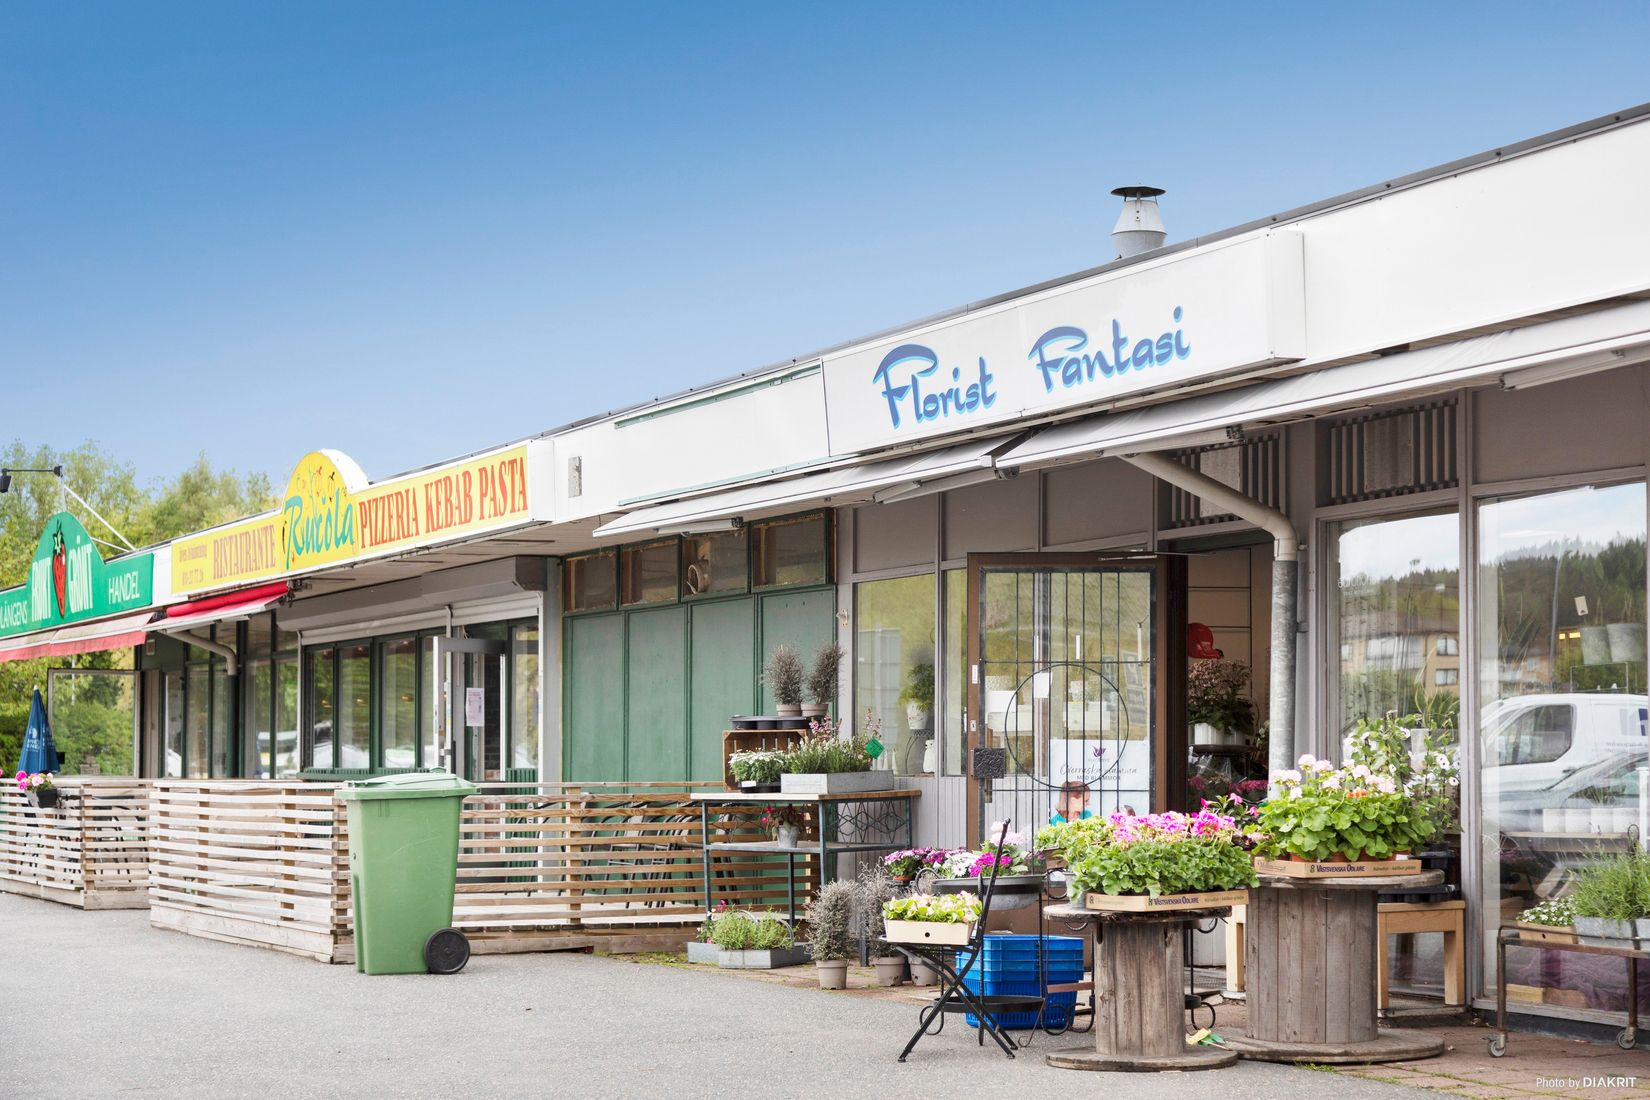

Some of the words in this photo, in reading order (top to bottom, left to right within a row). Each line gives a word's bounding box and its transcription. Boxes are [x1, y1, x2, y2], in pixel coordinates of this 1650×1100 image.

[872, 343, 997, 430] Florist
[1027, 305, 1191, 394] Fantasi
[358, 487, 419, 549] PIZZERIA
[424, 470, 473, 534] KEBAB
[478, 456, 528, 521] PASTA
[108, 571, 140, 604] HANDEL
